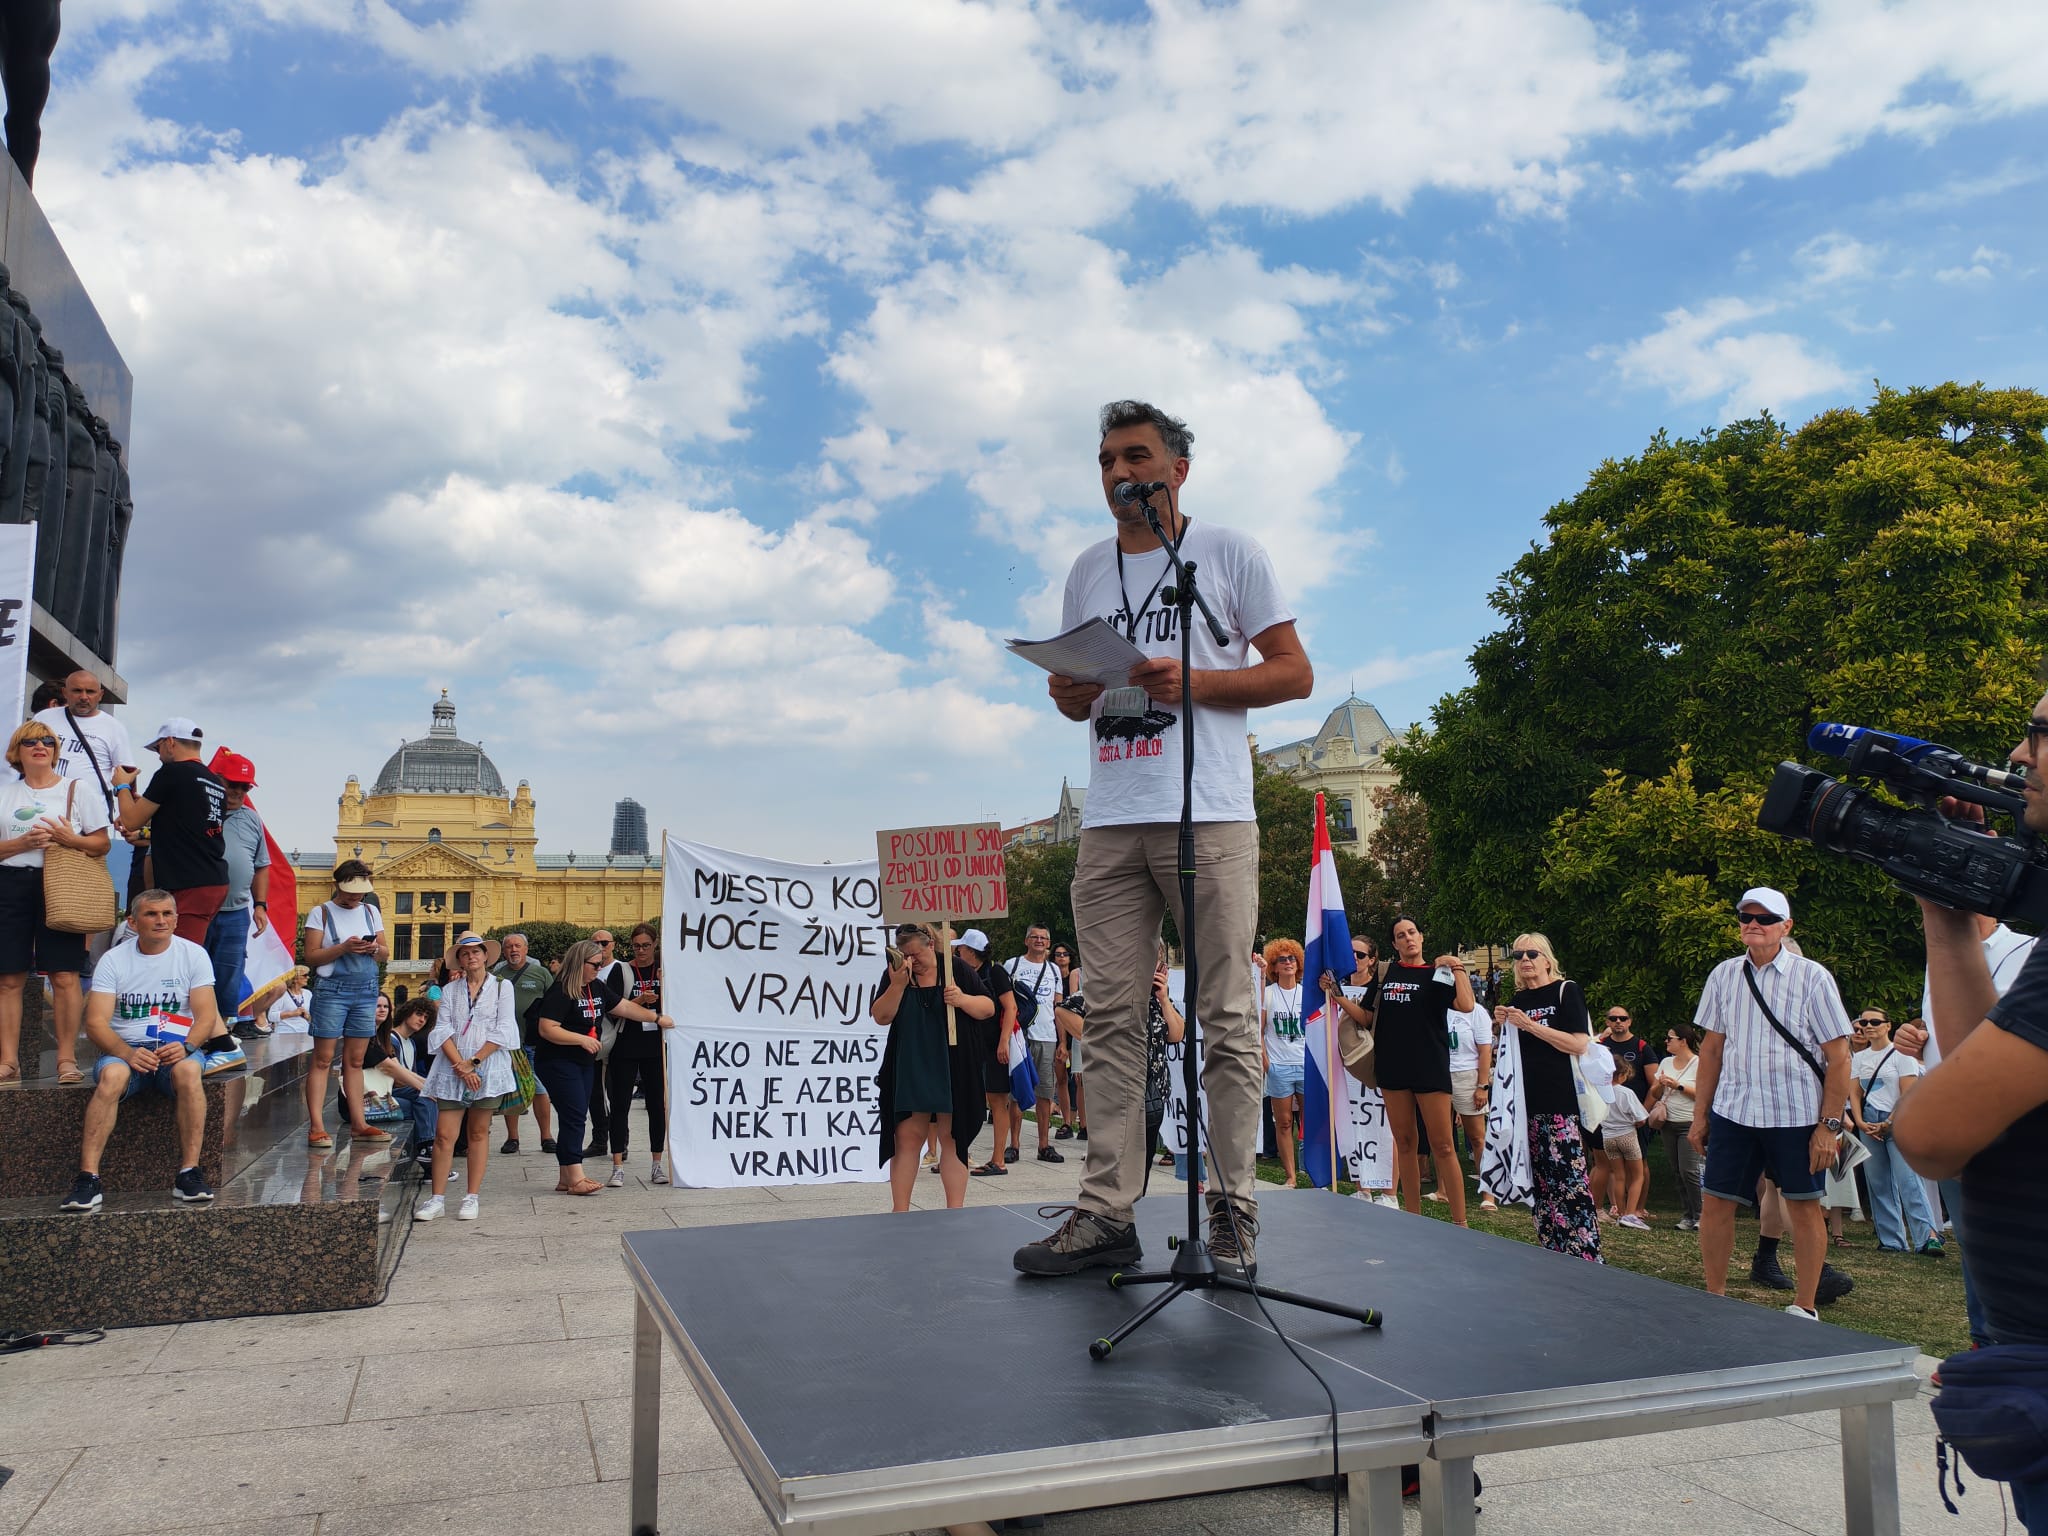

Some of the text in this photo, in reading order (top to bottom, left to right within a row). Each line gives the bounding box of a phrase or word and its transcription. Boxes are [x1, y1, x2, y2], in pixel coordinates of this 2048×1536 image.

[1146, 607, 1180, 644] TO!
[1136, 738, 1163, 757] BILO!
[890, 828, 1003, 859] POSUDILI SMO
[885, 854, 1006, 885] ZEMLJU OD UNUKA
[695, 868, 814, 909] MJESTO
[900, 880, 1007, 913] ZAŠTITIMO JU
[680, 910, 780, 953] HOĆE
[1382, 982, 1420, 991] AZBEST
[1383, 992, 1411, 1003] UBIJA
[691, 1035, 879, 1068] AKO NE ZNAŠ
[690, 1072, 747, 1106] ŠTA
[756, 1077, 783, 1110] JE
[712, 1111, 774, 1139] NEK
[782, 1112, 807, 1136] TI
[730, 1146, 863, 1178] VRANJIC
